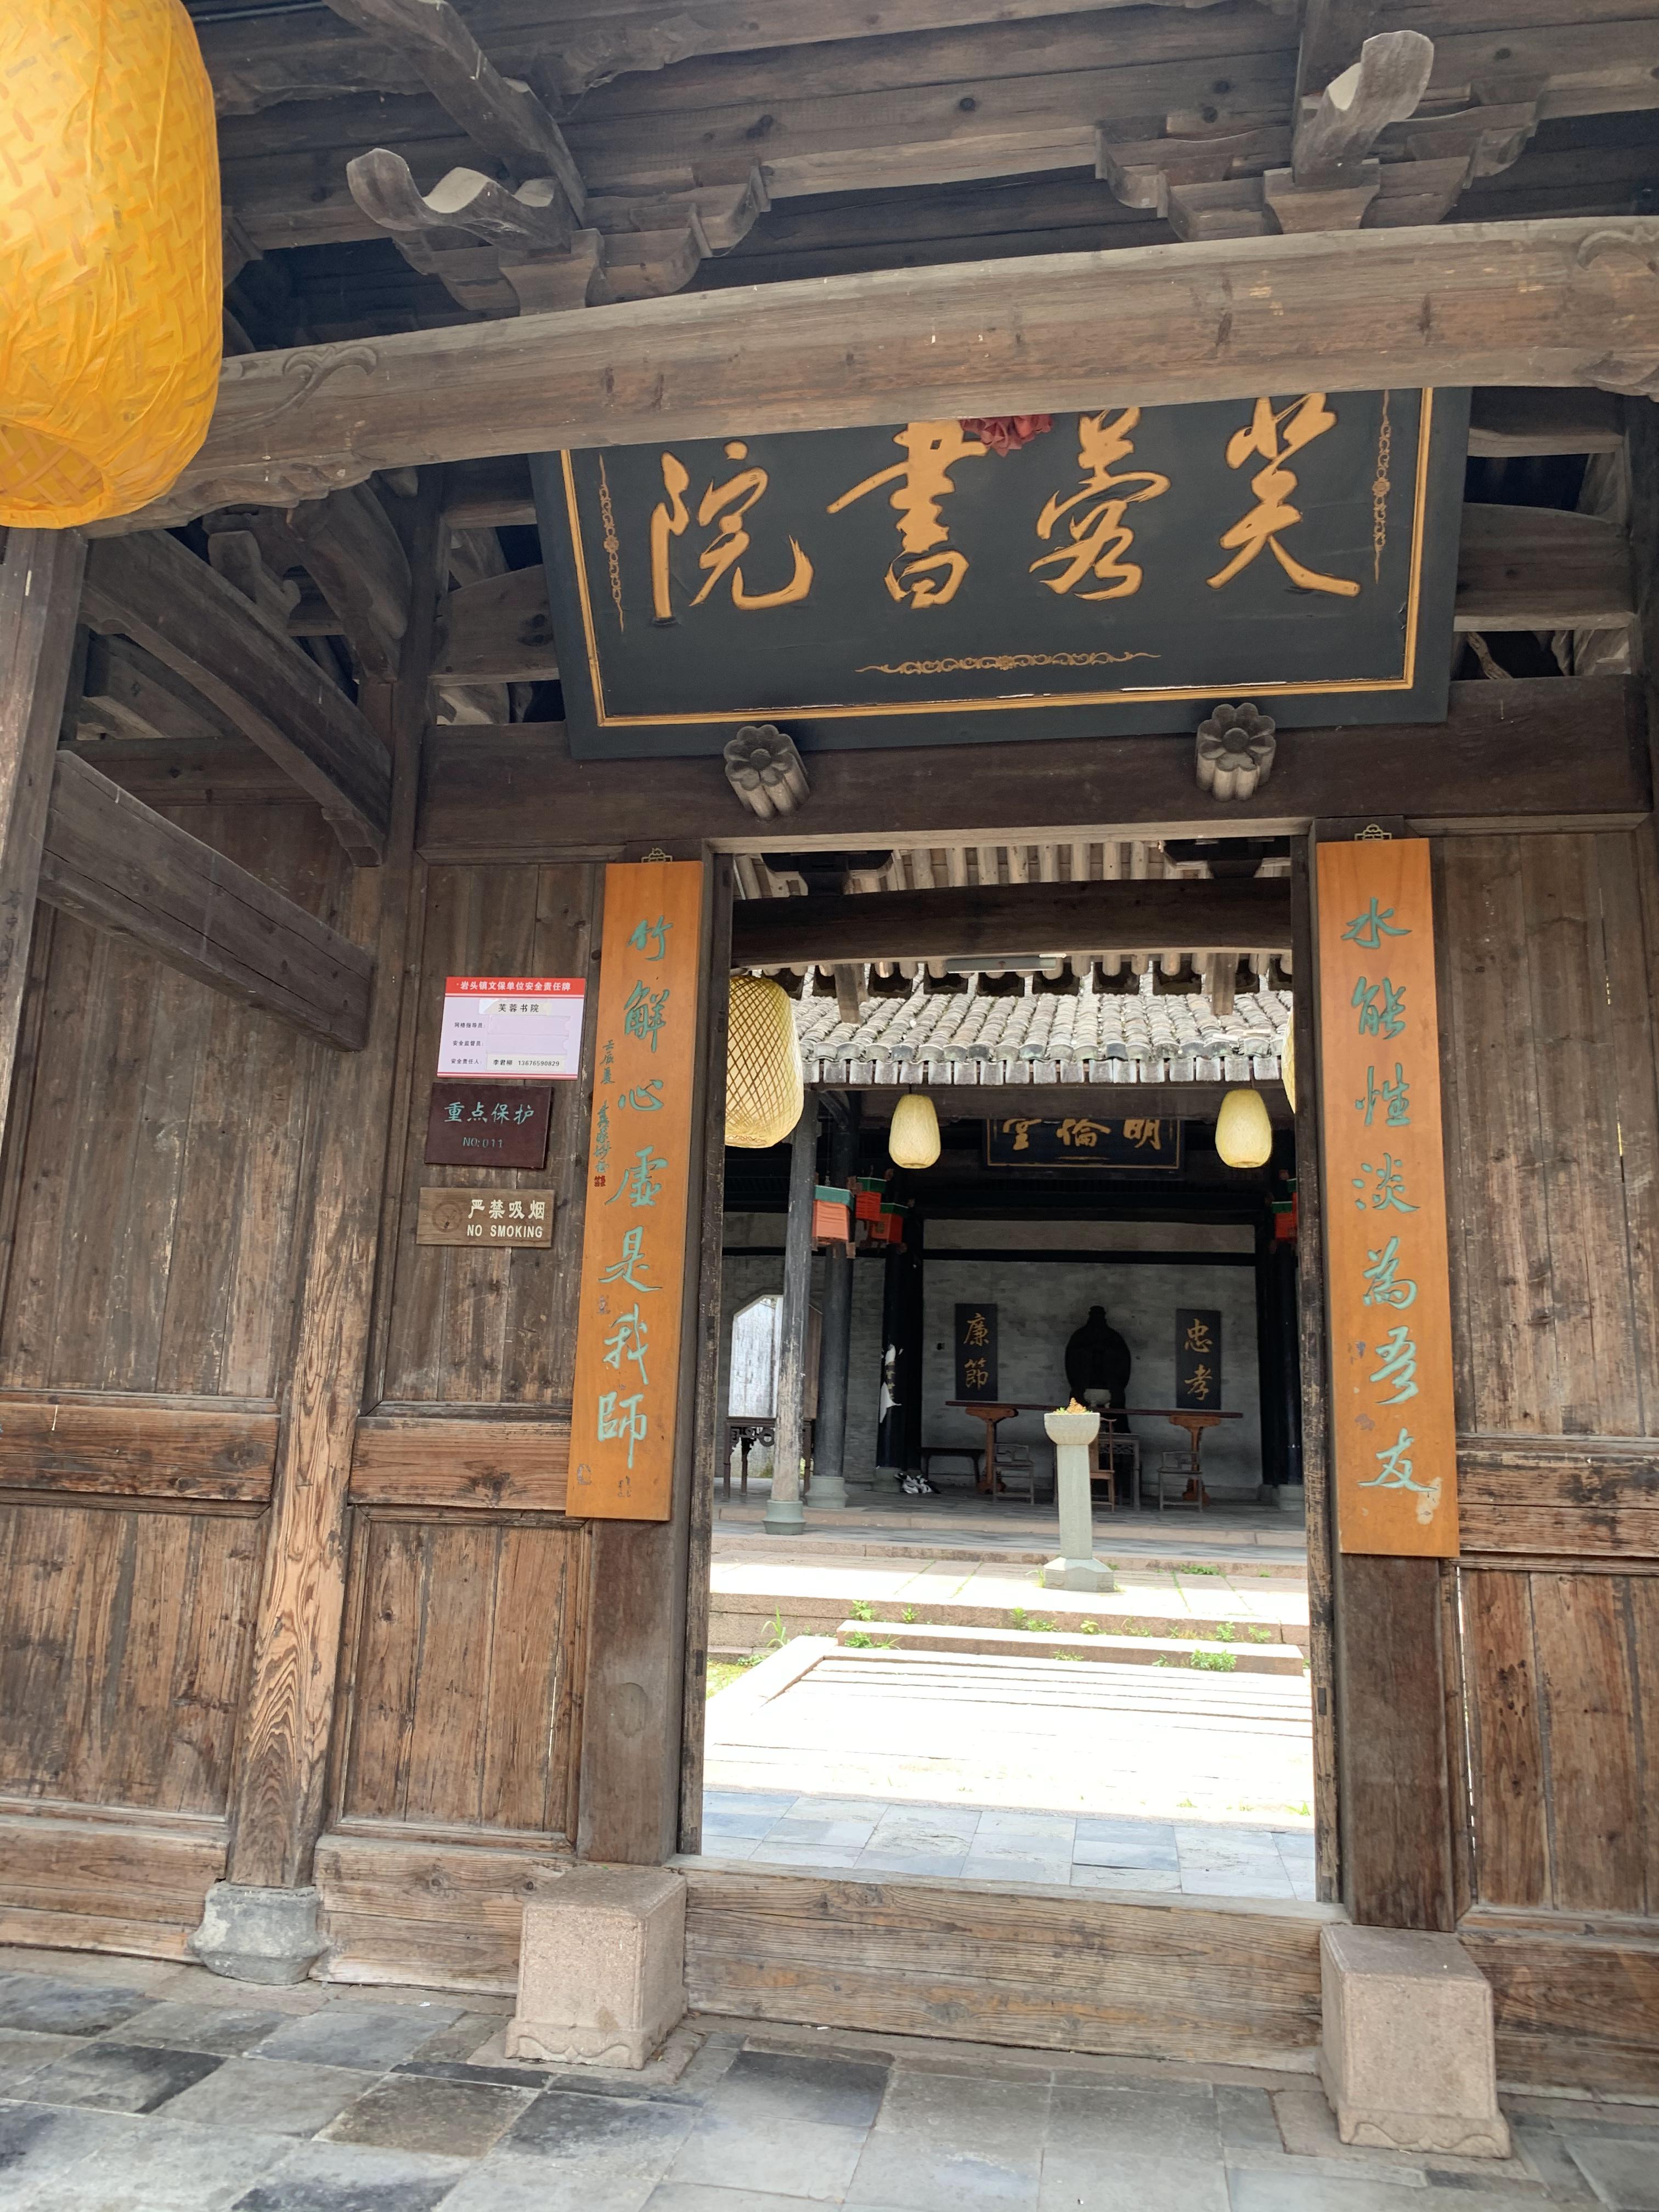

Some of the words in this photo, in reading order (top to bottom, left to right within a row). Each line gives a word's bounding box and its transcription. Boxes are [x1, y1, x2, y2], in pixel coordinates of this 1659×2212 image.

[460, 980, 571, 992] 岩头镇文保单位安全责任牌
[498, 1003, 539, 1013] 芙蓉书院
[444, 1102, 534, 1125] 重点保护
[468, 1199, 545, 1220] 严禁吸烟
[467, 1224, 482, 1237] NO
[490, 1224, 543, 1238] SMOKING
[1184, 1318, 1212, 1401] 忠孝
